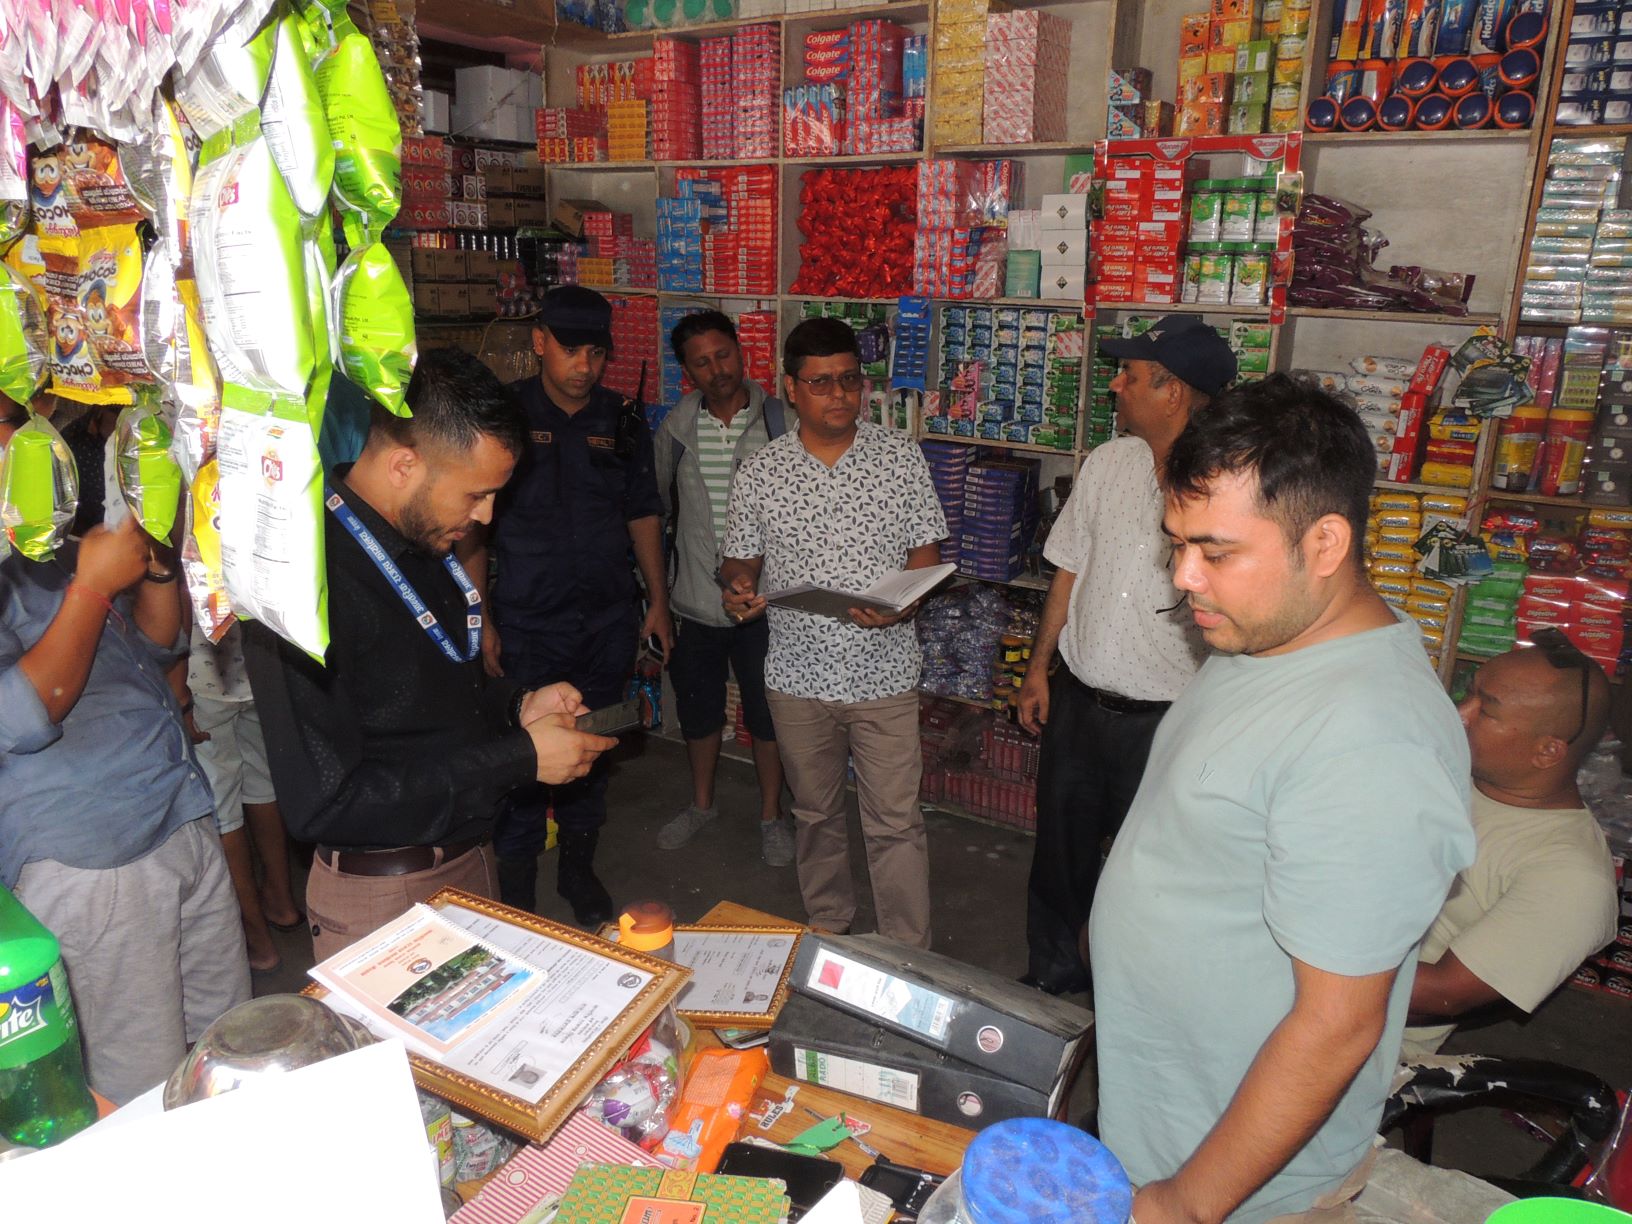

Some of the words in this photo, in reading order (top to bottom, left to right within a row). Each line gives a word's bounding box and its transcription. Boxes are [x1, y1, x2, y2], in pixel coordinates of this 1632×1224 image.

[806, 34, 841, 45] Colgate
[806, 50, 841, 61] Colgate
[806, 65, 841, 76] Colgate
[1532, 587, 1563, 596] Digestive
[1526, 610, 1558, 618] Digestive
[1580, 617, 1612, 626] Digestive
[820, 1056, 828, 1082] RADO
[761, 1105, 784, 1129] RULES
